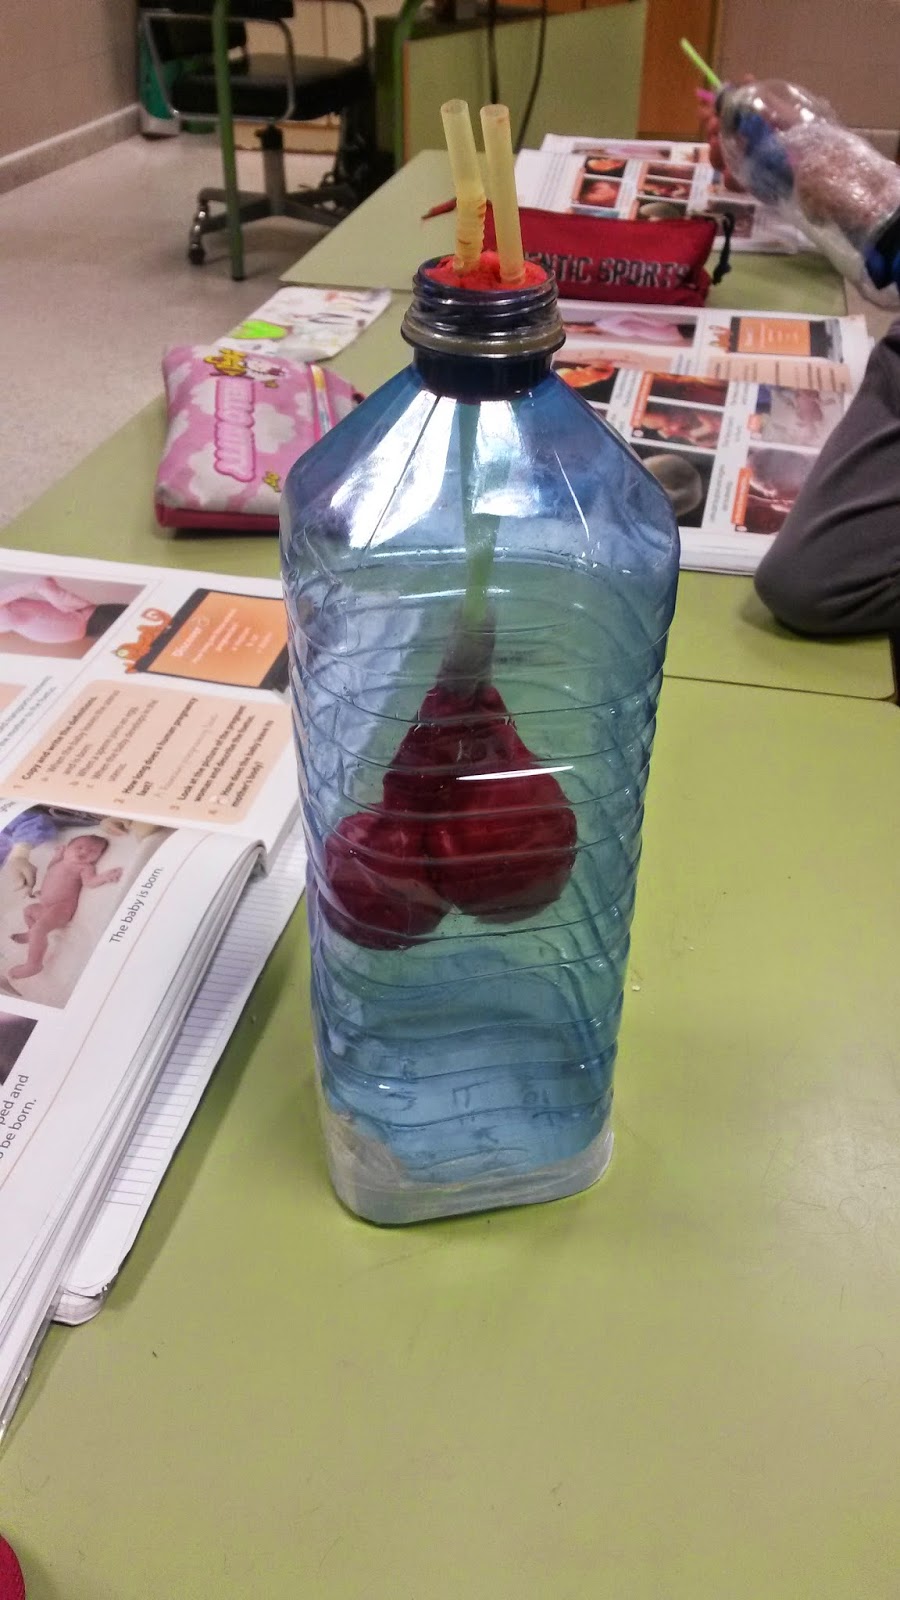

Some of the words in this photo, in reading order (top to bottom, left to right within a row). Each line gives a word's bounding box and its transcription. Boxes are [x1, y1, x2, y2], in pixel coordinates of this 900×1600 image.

[21, 764, 41, 779] Copy
[36, 751, 50, 762] and
[47, 736, 63, 750] write
[59, 726, 71, 735] the
[122, 780, 137, 793] How
[132, 765, 150, 779] long
[144, 751, 159, 764] does
[157, 726, 176, 745] human
[173, 698, 198, 725] pregnancy
[177, 785, 193, 800] Look
[193, 767, 204, 777] the
[201, 747, 218, 767] picture
[194, 779, 212, 801] woman
[209, 767, 220, 778] and
[216, 743, 236, 766] describe
[220, 781, 235, 795] How
[230, 767, 244, 780] does
[245, 742, 261, 756] baby
[231, 780, 252, 807] mother's
[136, 890, 149, 898] is
[141, 868, 164, 889] born.
[121, 899, 144, 923] baby
[109, 924, 128, 943] The
[10, 1074, 29, 1098] and
[0, 1133, 16, 1149] be
[8, 1099, 37, 1130] born.
